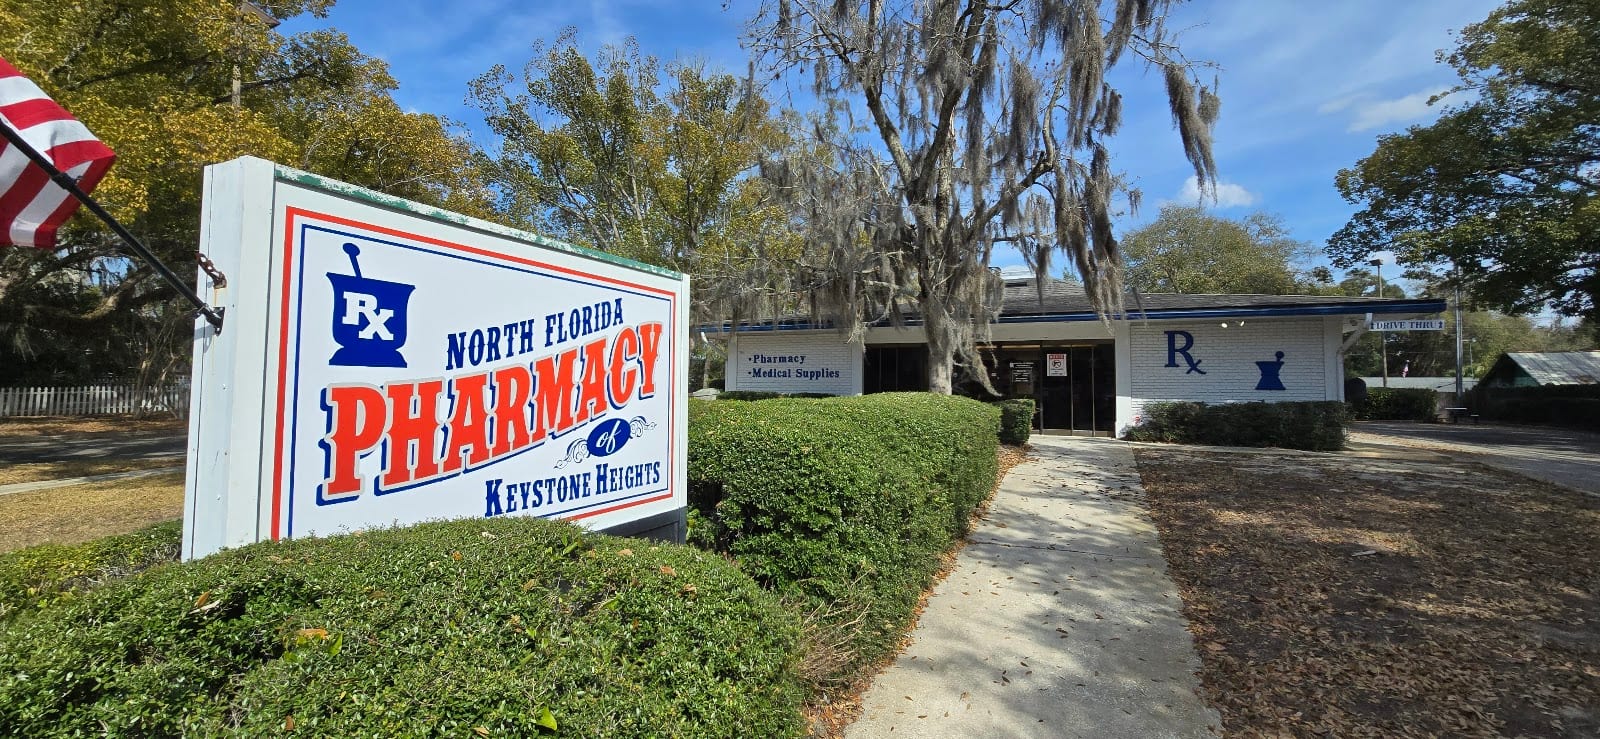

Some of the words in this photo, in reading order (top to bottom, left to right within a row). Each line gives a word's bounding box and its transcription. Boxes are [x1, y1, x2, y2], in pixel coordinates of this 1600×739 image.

[342, 291, 394, 341] Rx
[445, 318, 535, 371] NORTH
[544, 297, 624, 348] FLORIDA
[1376, 321, 1406, 330] DRIVE
[1408, 321, 1436, 330] THRU
[751, 367, 792, 379] Medical
[795, 368, 840, 380] Supplies
[752, 354, 807, 365] Pharmacy
[317, 321, 664, 507] PHARMACY
[595, 419, 622, 454] of
[484, 471, 592, 518] KEYSTONE
[595, 461, 661, 496] HEIGHTS
